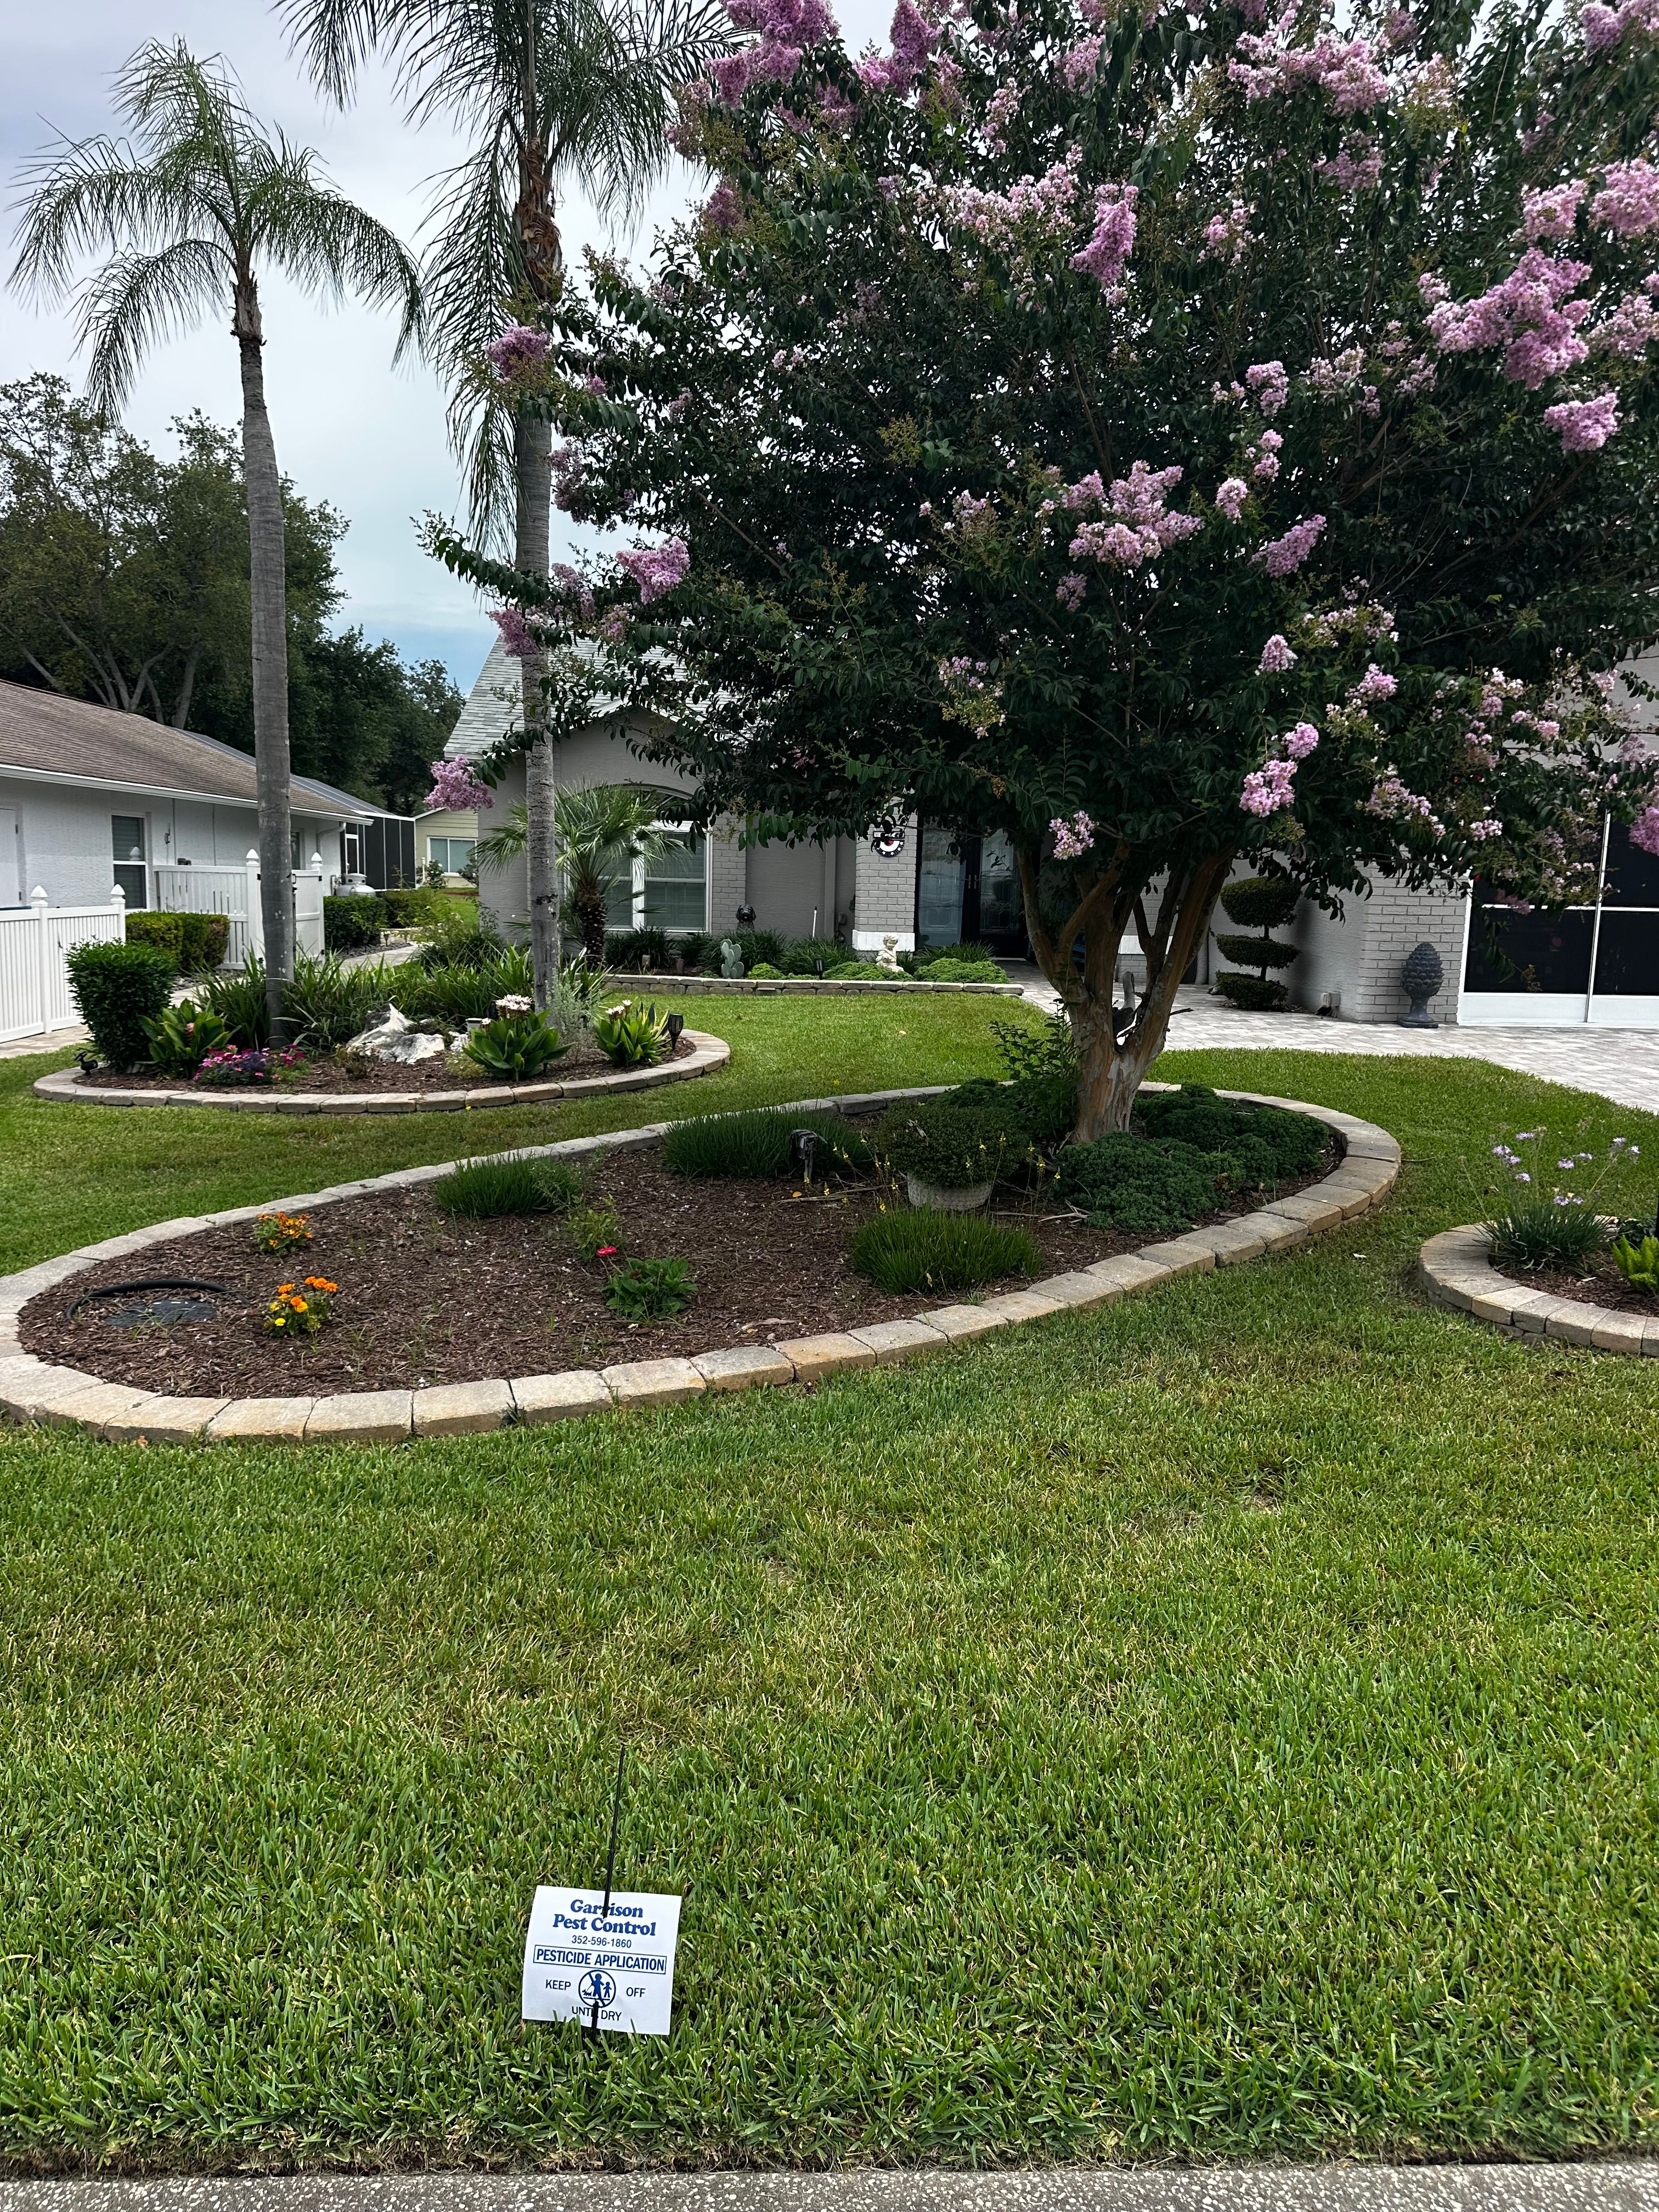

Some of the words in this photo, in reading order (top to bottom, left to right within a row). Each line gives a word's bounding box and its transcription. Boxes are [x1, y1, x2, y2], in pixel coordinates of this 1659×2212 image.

[571, 1899, 643, 1918] Garison
[552, 1914, 588, 1930] Pest
[591, 1917, 656, 1936] Control
[571, 1935, 632, 1948] 352-596-1860
[537, 1949, 592, 1965] PESTICIDE
[594, 1954, 664, 1971] APPLICATION
[545, 1979, 571, 1990] KEEP
[626, 1987, 646, 1997] OFF
[572, 2006, 599, 2018] UNTI
[601, 2010, 622, 2021] DRY
